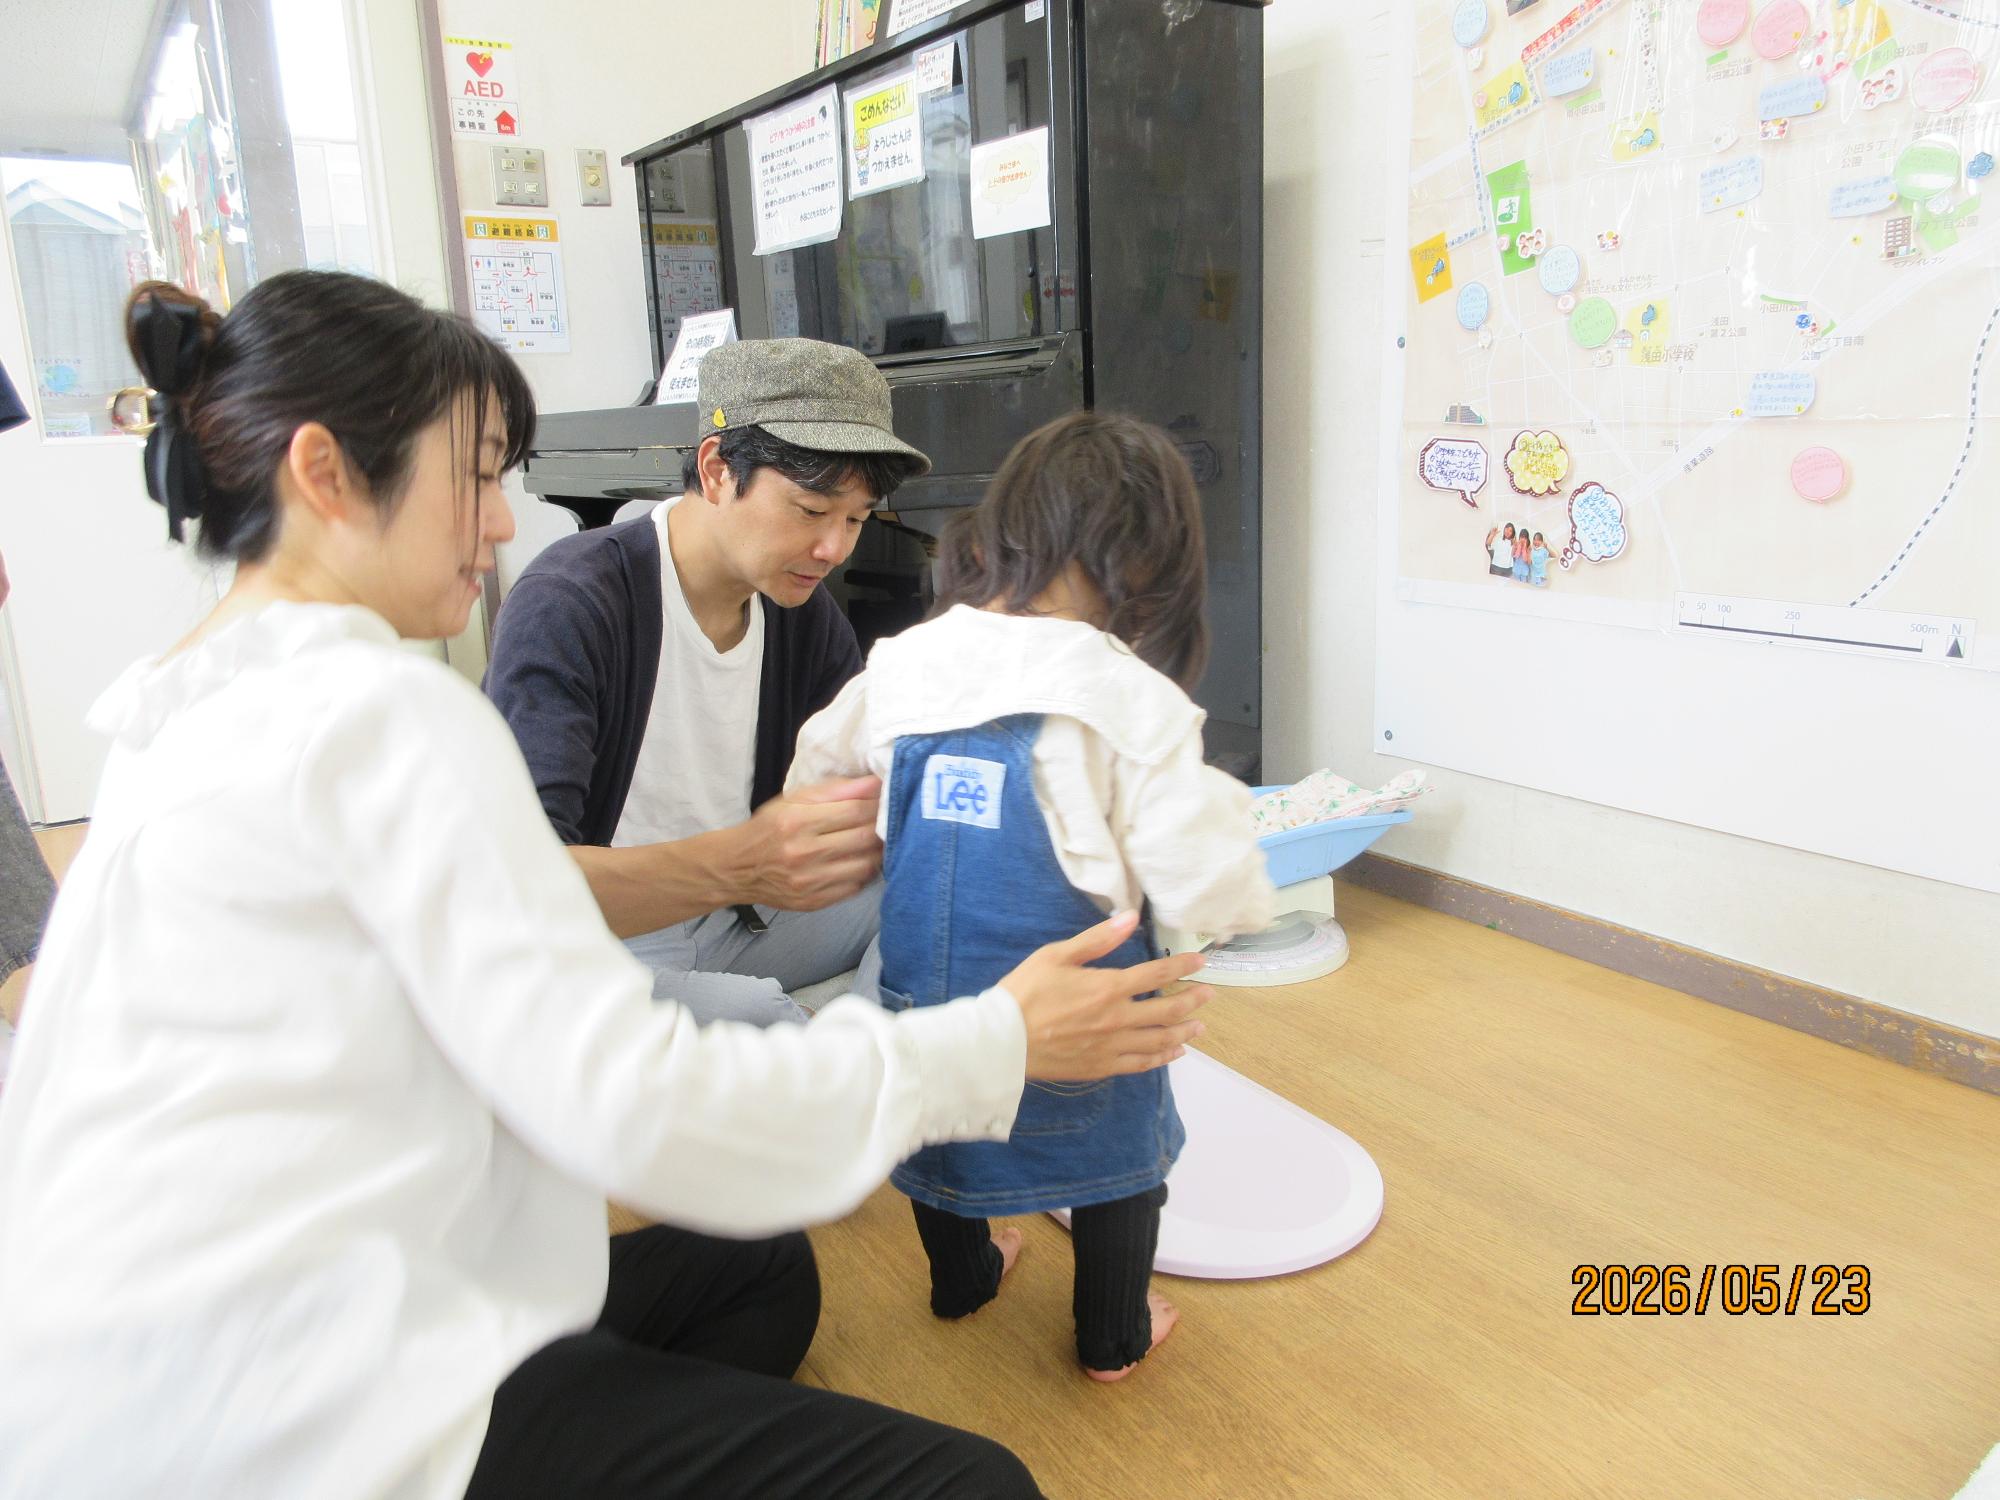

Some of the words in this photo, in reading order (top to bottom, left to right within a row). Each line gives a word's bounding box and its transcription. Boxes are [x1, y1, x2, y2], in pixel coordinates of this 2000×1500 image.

[464, 80, 504, 98] AED
[457, 108, 485, 119] この先
[860, 96, 906, 121] ごめんなさい
[873, 128, 913, 152] ようじさんは
[1680, 601, 1685, 609] 0
[1696, 602, 1706, 611] 50
[1716, 604, 1732, 614] 100
[1784, 611, 1801, 621] 250
[1910, 622, 1939, 634] 500m
[1951, 623, 1962, 635] N
[935, 773, 987, 815] Lee
